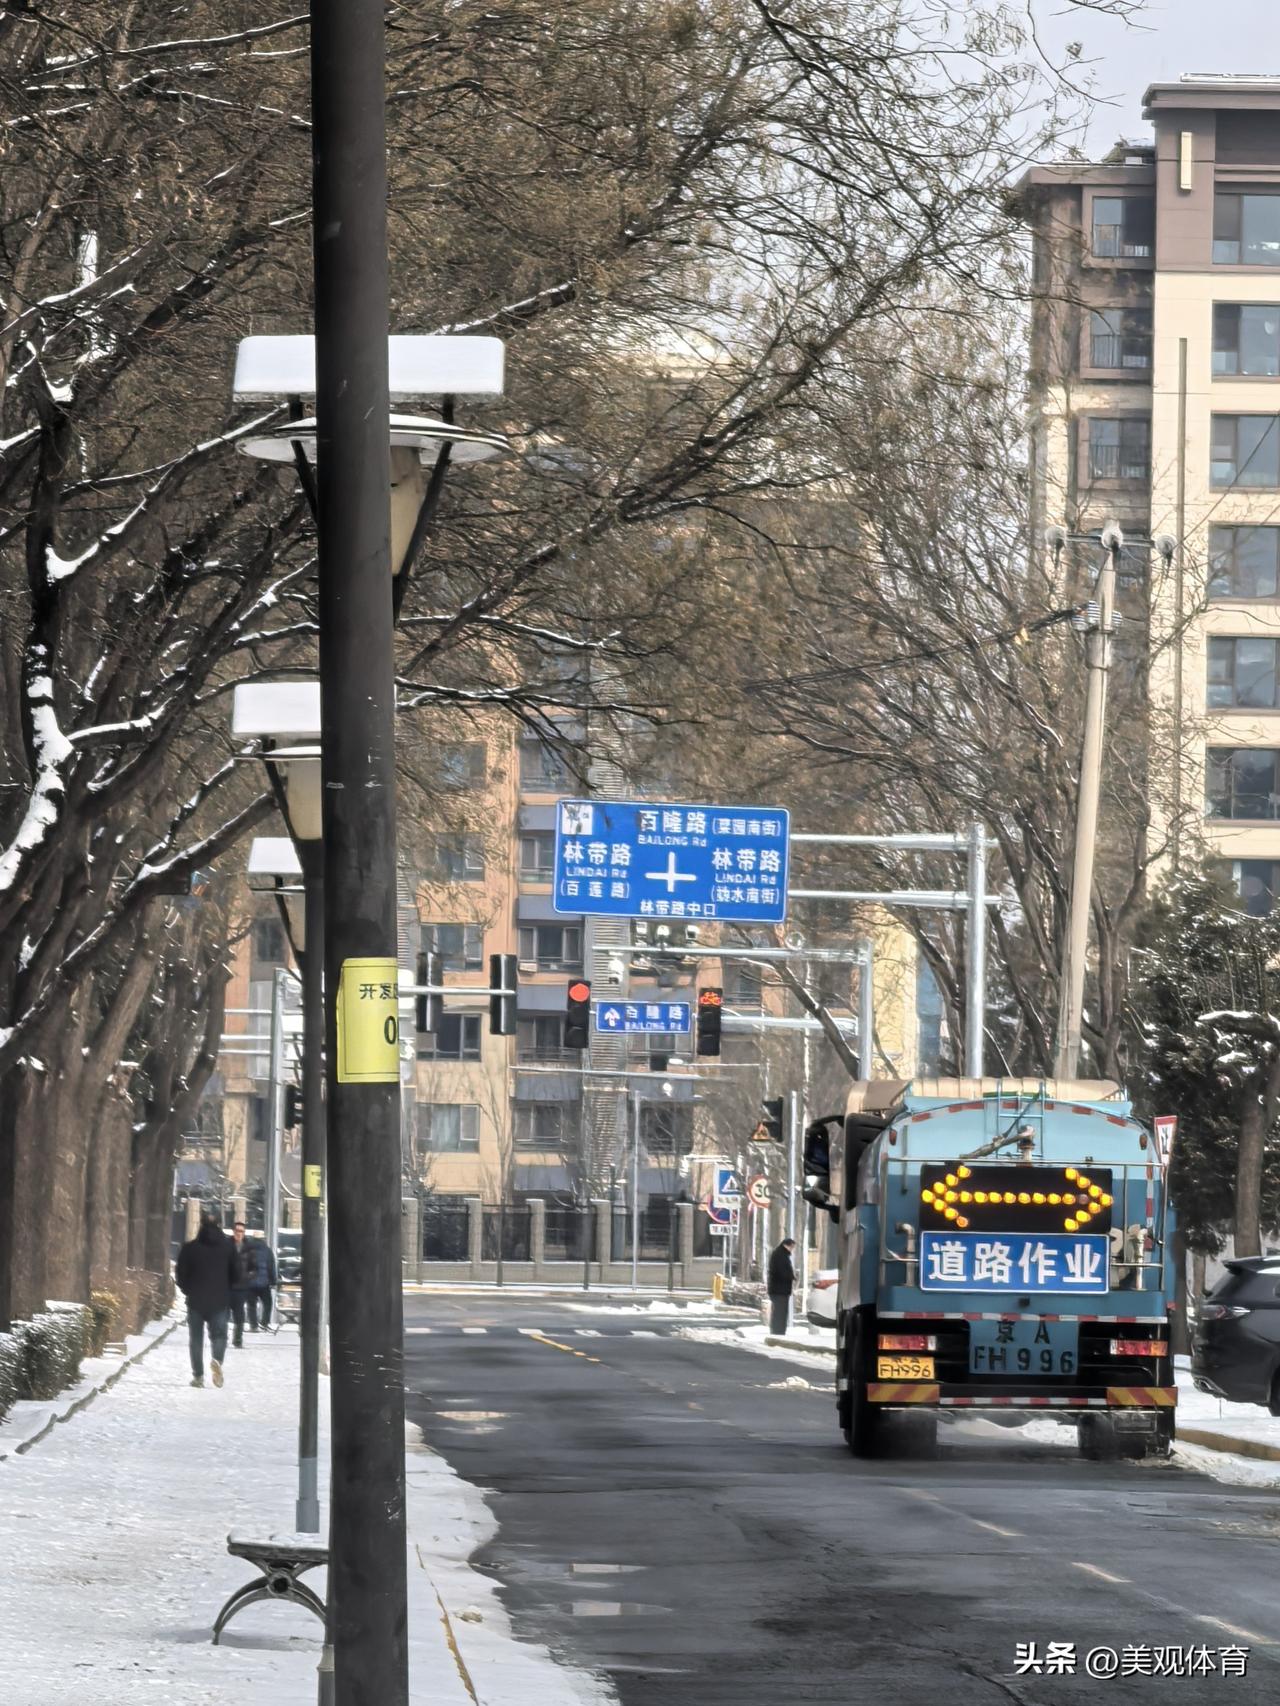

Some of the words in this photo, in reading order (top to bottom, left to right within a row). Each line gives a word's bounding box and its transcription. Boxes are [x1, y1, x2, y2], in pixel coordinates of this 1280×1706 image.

[639, 810, 706, 834] 百隆路
[638, 834, 688, 846] BAILONG
[692, 837, 707, 848] Rd
[563, 841, 631, 867] 林带路
[712, 848, 782, 872] 林带路
[566, 867, 607, 878] LINDAI
[611, 868, 628, 879] Rd
[715, 873, 756, 884] LINDAI
[761, 875, 776, 885] Rd
[384, 1015, 398, 1046] 0
[928, 1240, 1103, 1285] 道路作业
[879, 1363, 931, 1378] FH996
[973, 1346, 1075, 1375] FH996
